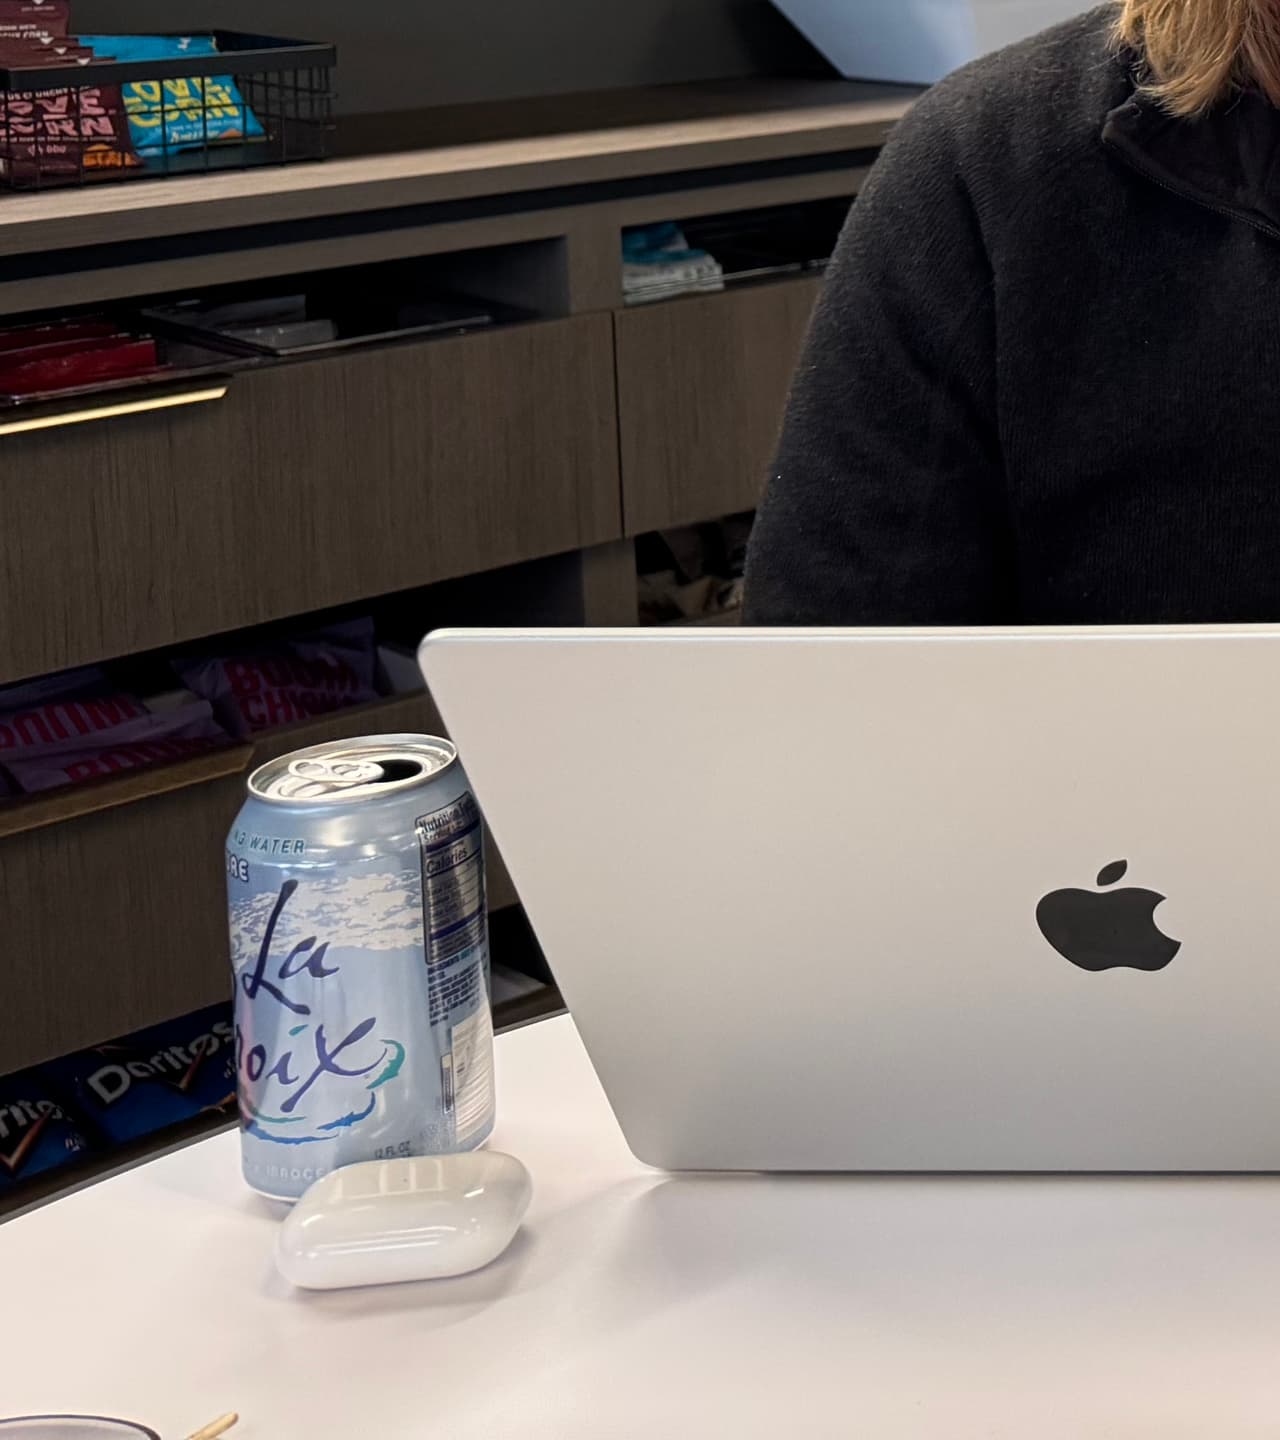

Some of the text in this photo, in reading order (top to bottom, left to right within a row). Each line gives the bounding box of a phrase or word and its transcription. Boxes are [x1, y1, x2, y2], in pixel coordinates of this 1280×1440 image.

[249, 836, 305, 855] WATER
[242, 878, 341, 1016] La
[86, 1020, 233, 1106] Doritos
